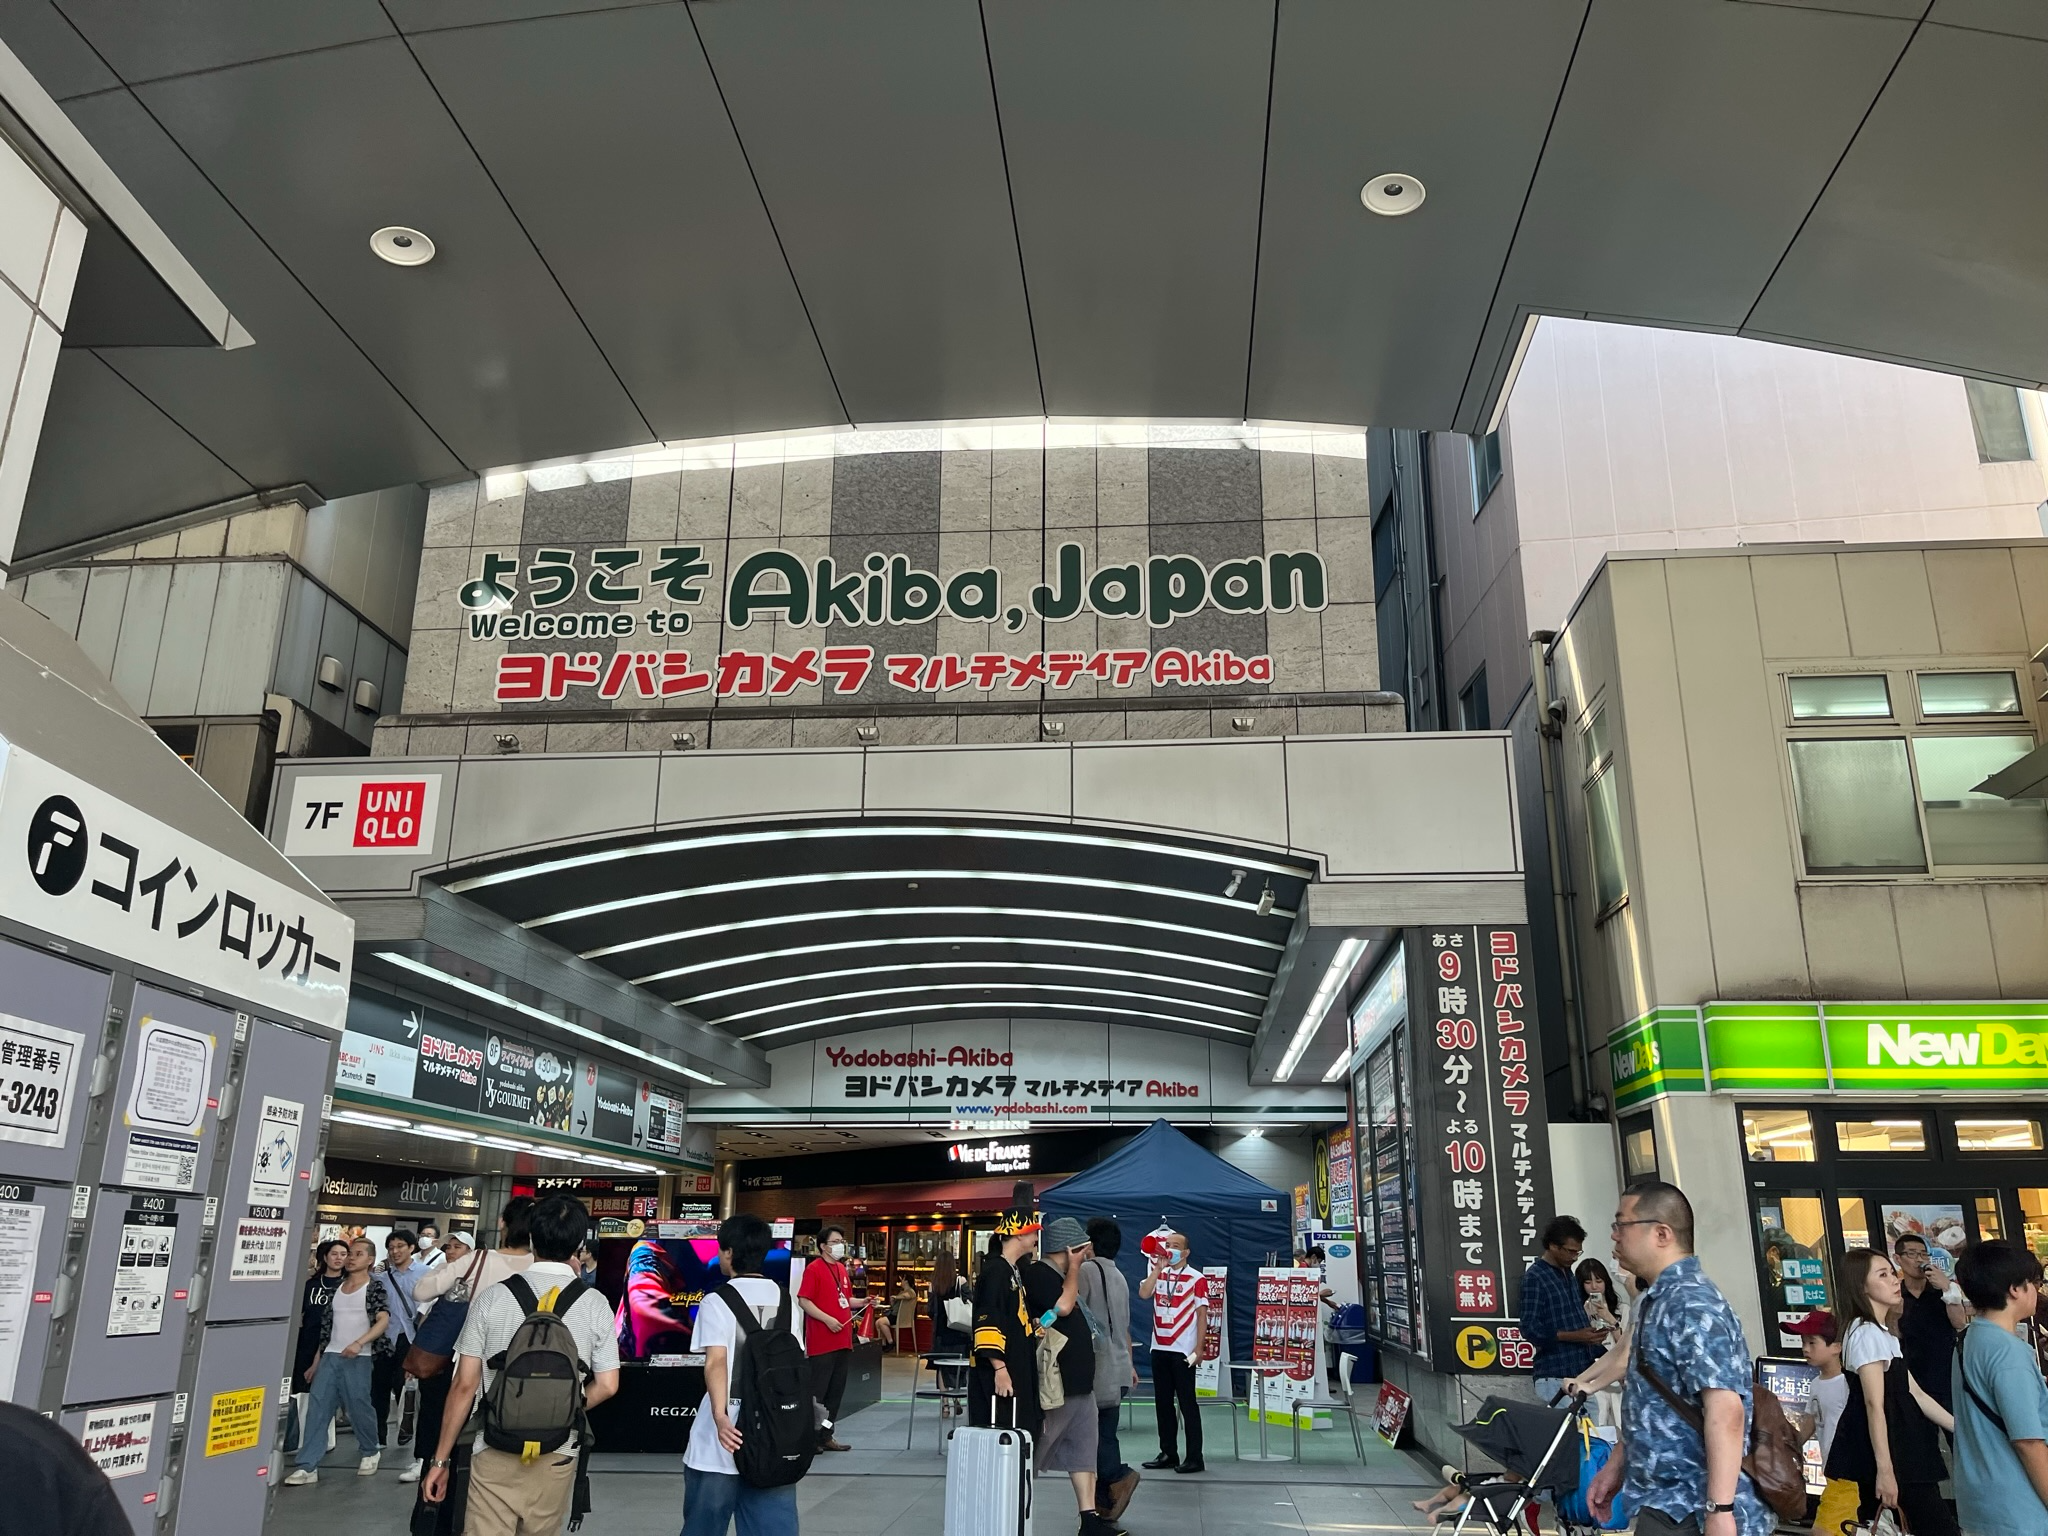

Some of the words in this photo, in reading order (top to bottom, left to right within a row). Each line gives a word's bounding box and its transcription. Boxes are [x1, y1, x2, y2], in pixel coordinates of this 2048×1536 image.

[458, 546, 712, 608] ようこそ
[727, 550, 1026, 633] Akiba,
[1030, 541, 1328, 627] Japan
[471, 611, 635, 639] Welcome
[648, 609, 691, 634] to
[496, 645, 874, 702] ヨドバシカメラ
[885, 649, 1150, 692] マルチメディア
[1153, 648, 1274, 686] Akiba
[366, 790, 413, 813] UNI
[305, 802, 343, 829] 7F
[362, 817, 413, 843] QLO
[91, 832, 341, 986] コインロッカー
[2, 1039, 61, 1075] 管理番号
[421, 1034, 484, 1070] ヨドバシカメラ
[489, 1043, 499, 1058] 8F
[826, 1046, 1013, 1067] Yodobashi-Akiba
[1613, 1040, 1660, 1082] NewDays
[422, 1060, 460, 1080] マルチメディア
[459, 1069, 477, 1086] Akiba
[845, 1075, 1017, 1098] ヨドバシカメラ
[1024, 1079, 1142, 1097] マルチメディア
[1146, 1080, 1199, 1098] Akiba
[1490, 931, 1529, 1116] ヨドバシカメラ
[1510, 1124, 1537, 1246] マルチメディア
[497, 1090, 532, 1110] GOURMET
[597, 1096, 634, 1117] Yodobashi-Akiba
[955, 1102, 1089, 1115] www.yodobashi.com
[988, 1141, 1031, 1161] FRANCE
[322, 1175, 378, 1198] Restaurants
[400, 1175, 430, 1203] atré
[583, 1179, 612, 1188] Akiba
[143, 1197, 165, 1210] ¥400
[252, 1206, 270, 1218] ¥500
[320, 1213, 338, 1222] Directory
[1801, 1265, 1822, 1275] 公共料金
[1805, 1289, 1825, 1300] たばこ
[1497, 1327, 1526, 1341] 収容
[1467, 1334, 1485, 1361] P
[1500, 1342, 1537, 1369] 52
[1764, 1376, 1811, 1397] 北海道
[650, 1406, 699, 1417] REGZA
